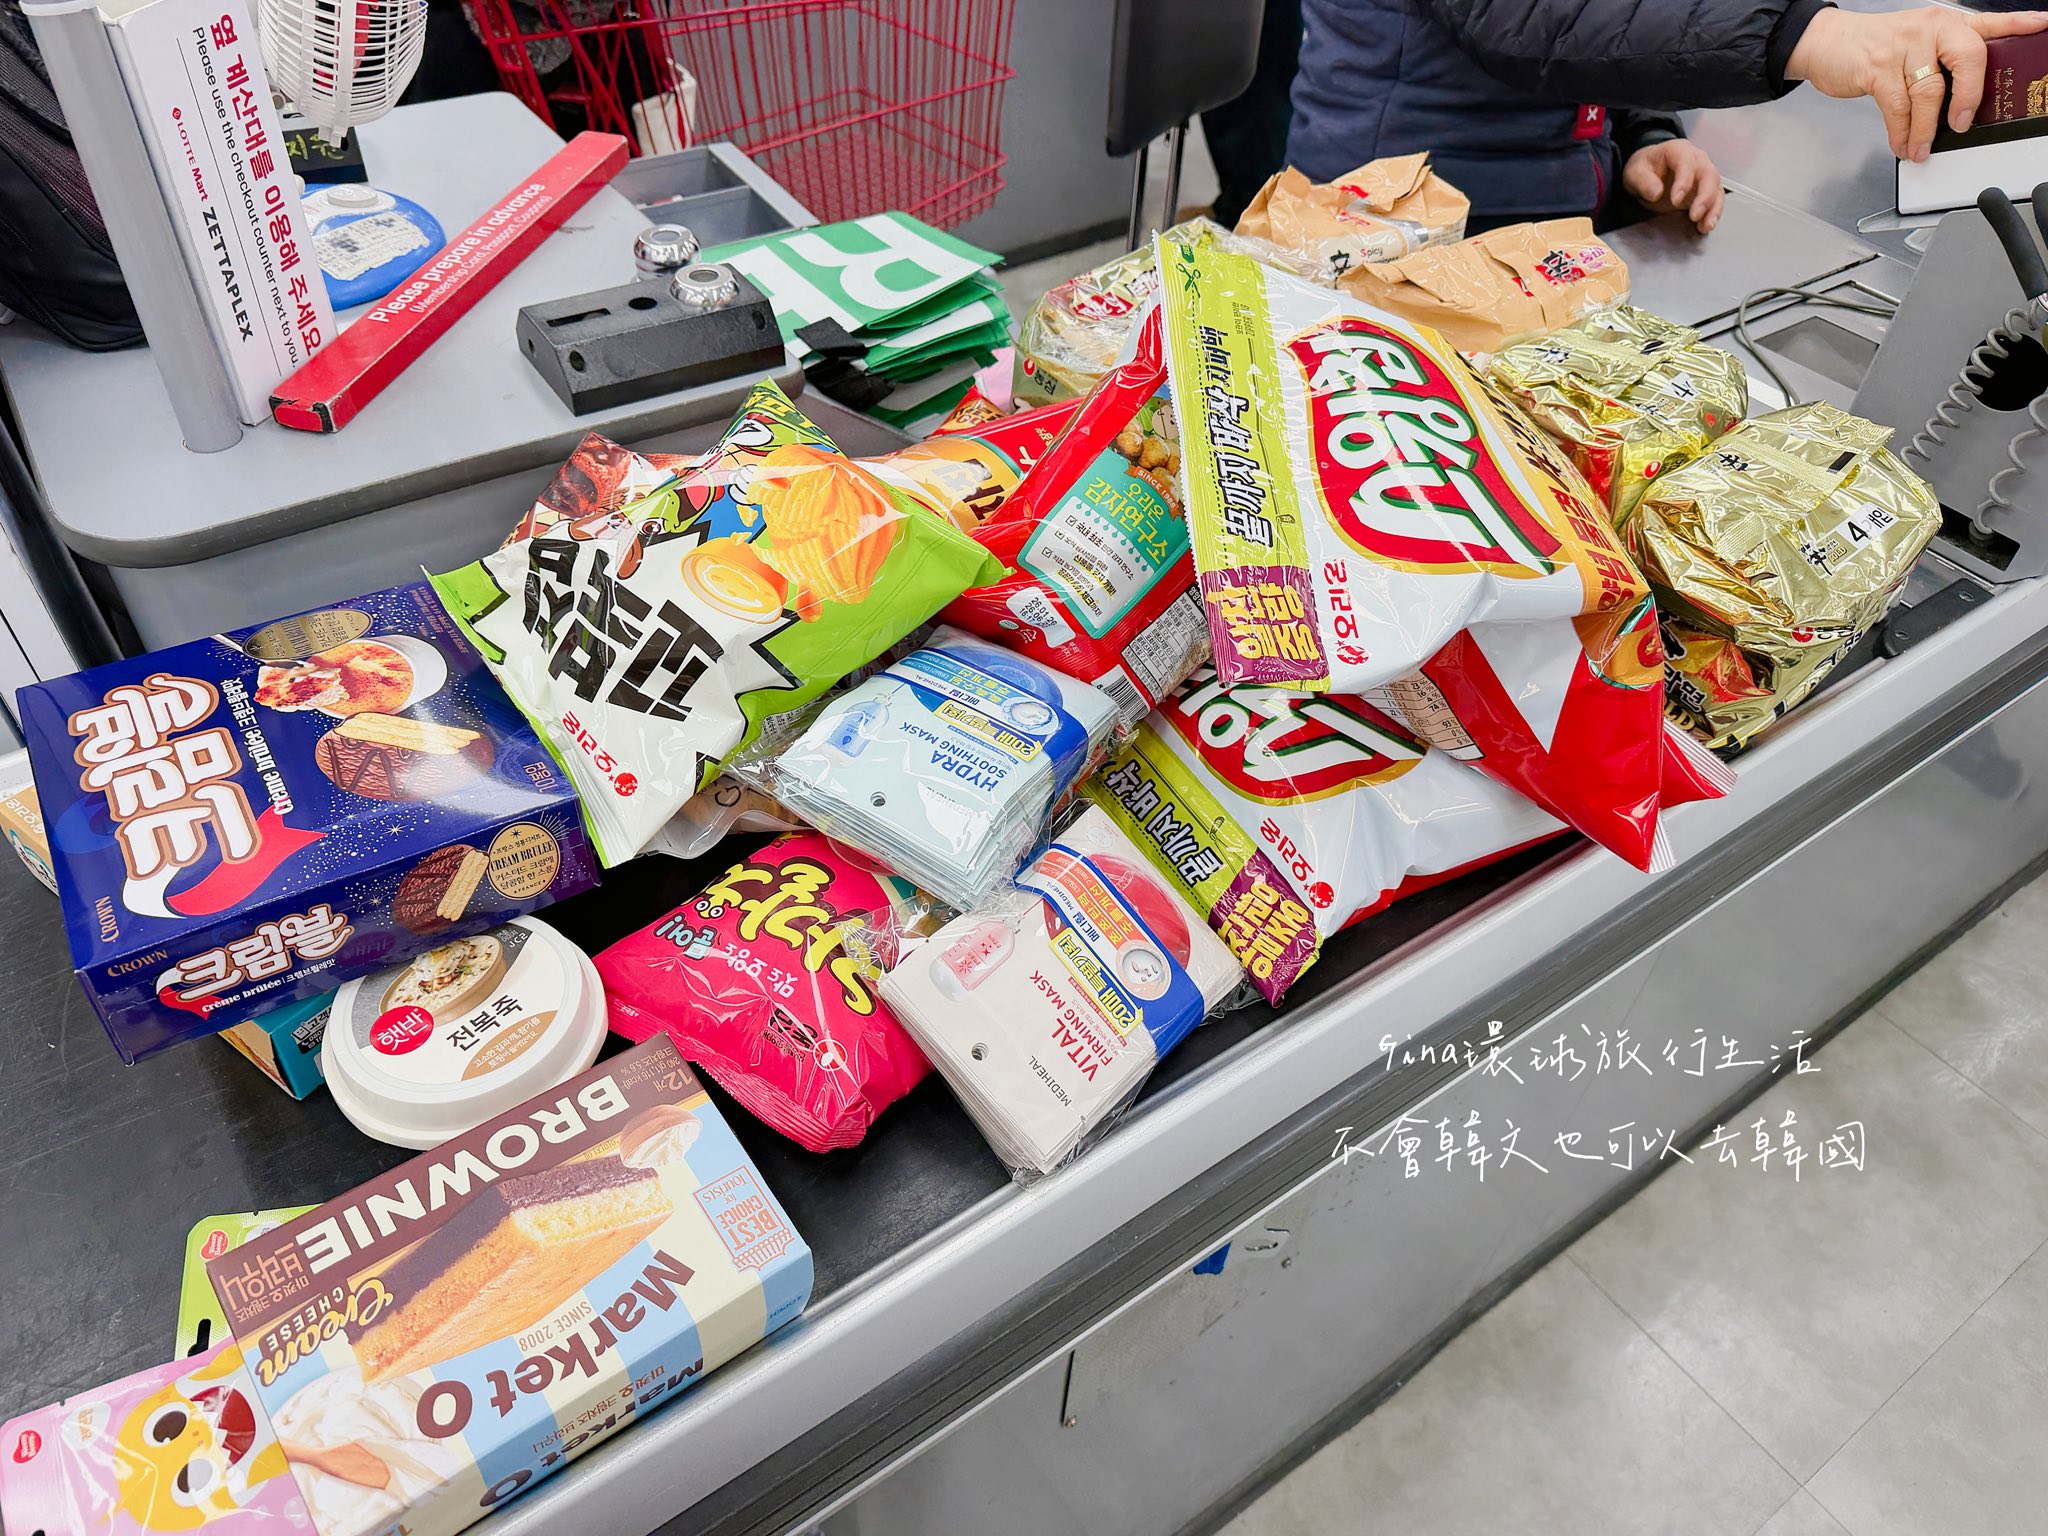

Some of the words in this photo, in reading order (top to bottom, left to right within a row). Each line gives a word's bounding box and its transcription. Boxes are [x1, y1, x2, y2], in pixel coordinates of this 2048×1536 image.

[193, 27, 216, 86] Please
[211, 88, 228, 118] use
[222, 121, 236, 150] the
[210, 14, 238, 50] 옆
[226, 54, 275, 181] 계산대를
[264, 185, 300, 272] 이용해
[288, 274, 321, 356] 주세요
[231, 152, 260, 226] checkout
[177, 122, 197, 166] LOTTE
[191, 167, 209, 201] Mart
[202, 207, 254, 342] ZETTAPLEX
[368, 280, 430, 322] Please
[422, 235, 481, 281] prepare
[473, 221, 496, 242] in
[487, 183, 546, 227] advance
[1360, 247, 1384, 260] Spicy
[253, 229, 276, 283] counter
[271, 286, 287, 320] next
[410, 266, 469, 313] (Membership
[281, 321, 290, 337] to
[284, 336, 299, 368] you.
[1307, 328, 1556, 580] 스윙칩
[1137, 469, 1161, 489] SINCE
[1084, 477, 1169, 564] 감자연구소
[1123, 482, 1165, 525] 오리온
[1328, 558, 1359, 638] 오리온
[523, 539, 725, 724] 꼬북칩
[948, 687, 980, 706] 메디힐
[239, 727, 277, 773] brûlée
[562, 711, 617, 774] 오리온
[899, 720, 940, 750] MASK
[996, 728, 1035, 757] 20매
[523, 761, 559, 793] 10봉입
[930, 750, 999, 793] HYDRA
[938, 741, 1008, 778] SOOTHING
[1105, 761, 1163, 822] 바삭
[490, 854, 520, 873] CREAM
[520, 840, 555, 862] BRULEE
[1147, 803, 1224, 888] 끝까지
[1260, 817, 1315, 882] 오리온
[518, 881, 542, 893] FRANCE
[95, 895, 120, 944] CROWN
[655, 914, 716, 959] 문어!
[1073, 912, 1100, 943] 메디힐
[106, 949, 169, 978] CROWN
[721, 943, 768, 978] 모양도
[1058, 933, 1108, 994] 특별기획
[766, 967, 799, 998] 맛도
[1029, 969, 1067, 1011] MASK
[446, 994, 524, 1050] 전복죽
[1098, 985, 1136, 1029] 20매
[375, 1009, 432, 1055] 햇반
[1051, 1017, 1099, 1082] VITAL
[1063, 1009, 1114, 1066] FIRMING
[642, 1046, 674, 1066] 크림치즈
[664, 1055, 681, 1070] 240
[654, 1074, 695, 1096] 12개
[1028, 1055, 1072, 1107] MEDIHEAL
[297, 1074, 631, 1271] BROWNIE
[716, 1195, 765, 1229] CHOICE
[724, 1192, 739, 1204] for
[733, 1211, 779, 1249] BEST
[220, 1241, 304, 1298] 브라우니
[272, 1277, 311, 1302] 마켓오
[236, 1293, 274, 1323] 크림치즈
[263, 1283, 346, 1352] CHEESE
[556, 1301, 592, 1332] SINCE
[255, 1277, 395, 1388] Cream
[486, 1249, 695, 1418] Market
[520, 1323, 555, 1353] 2008
[620, 1364, 666, 1399] 마켓오
[416, 1379, 474, 1439] O
[541, 1357, 705, 1468] Market
[577, 1393, 618, 1426] 크림치즈
[532, 1423, 576, 1454] 브라우니
[479, 1467, 533, 1508] O
